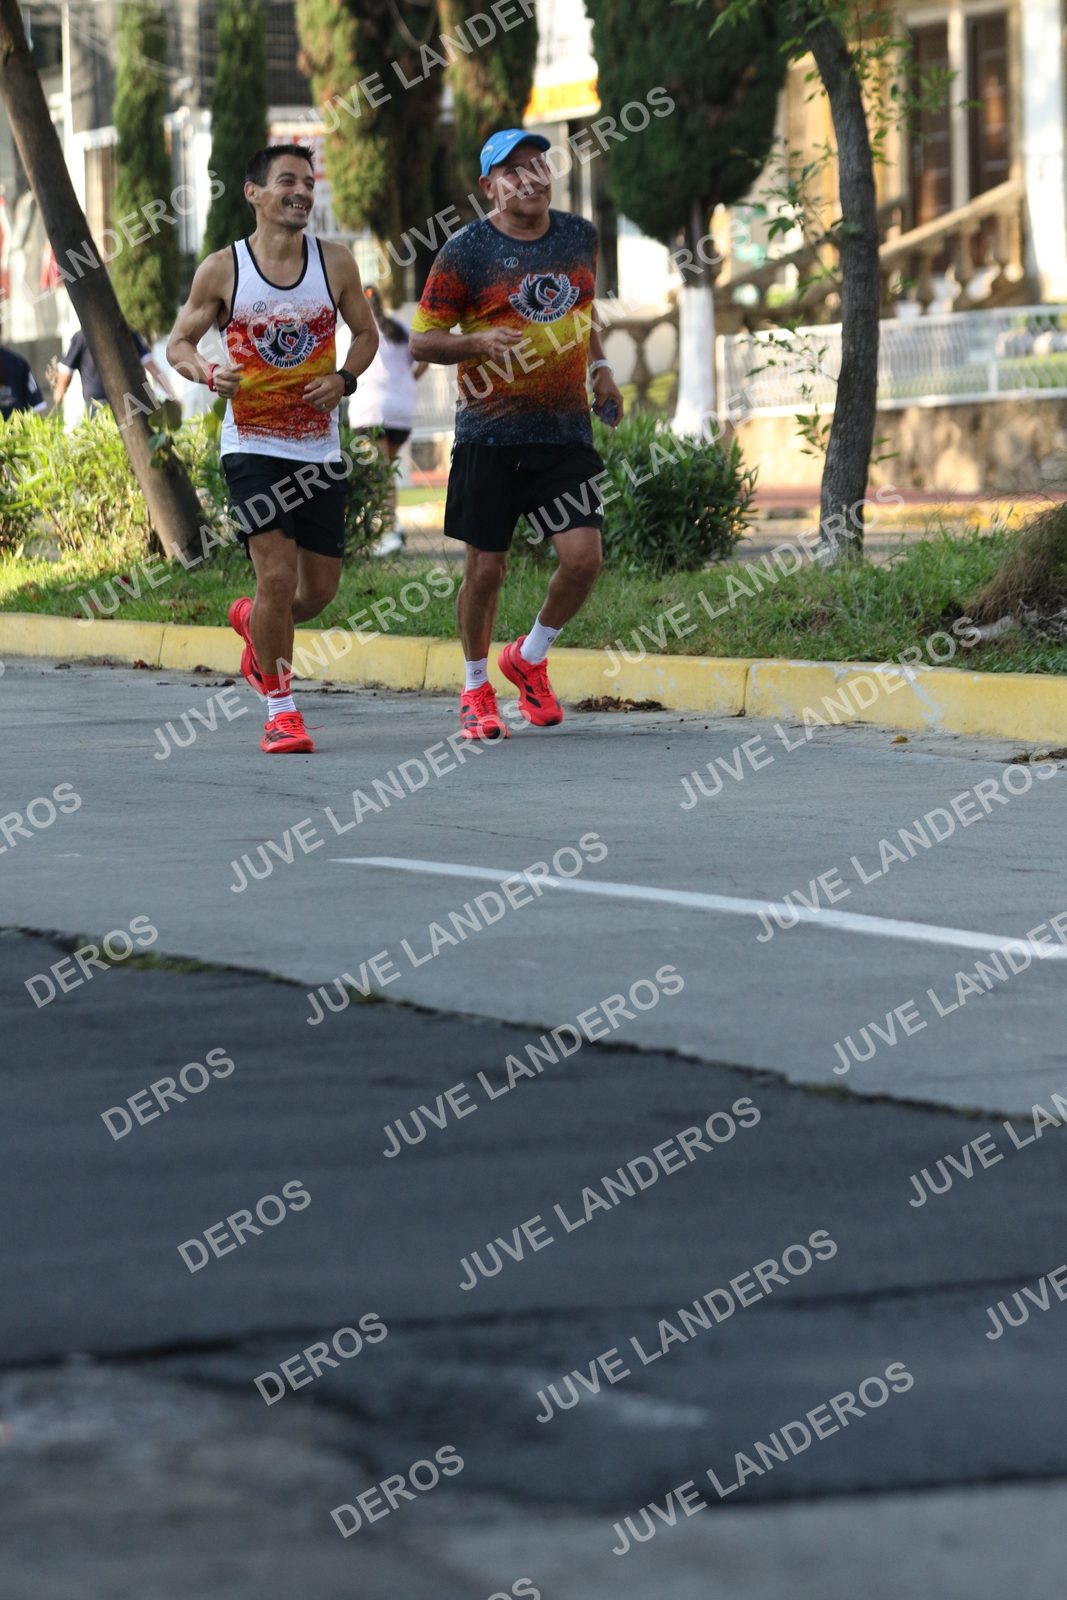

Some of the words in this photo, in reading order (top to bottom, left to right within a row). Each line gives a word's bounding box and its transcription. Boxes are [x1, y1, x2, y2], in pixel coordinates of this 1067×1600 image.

[531, 306, 566, 322] RUNNING
[563, 287, 578, 309] TEAM
[274, 353, 305, 368] RUNNING
[302, 335, 316, 357] TEAM
